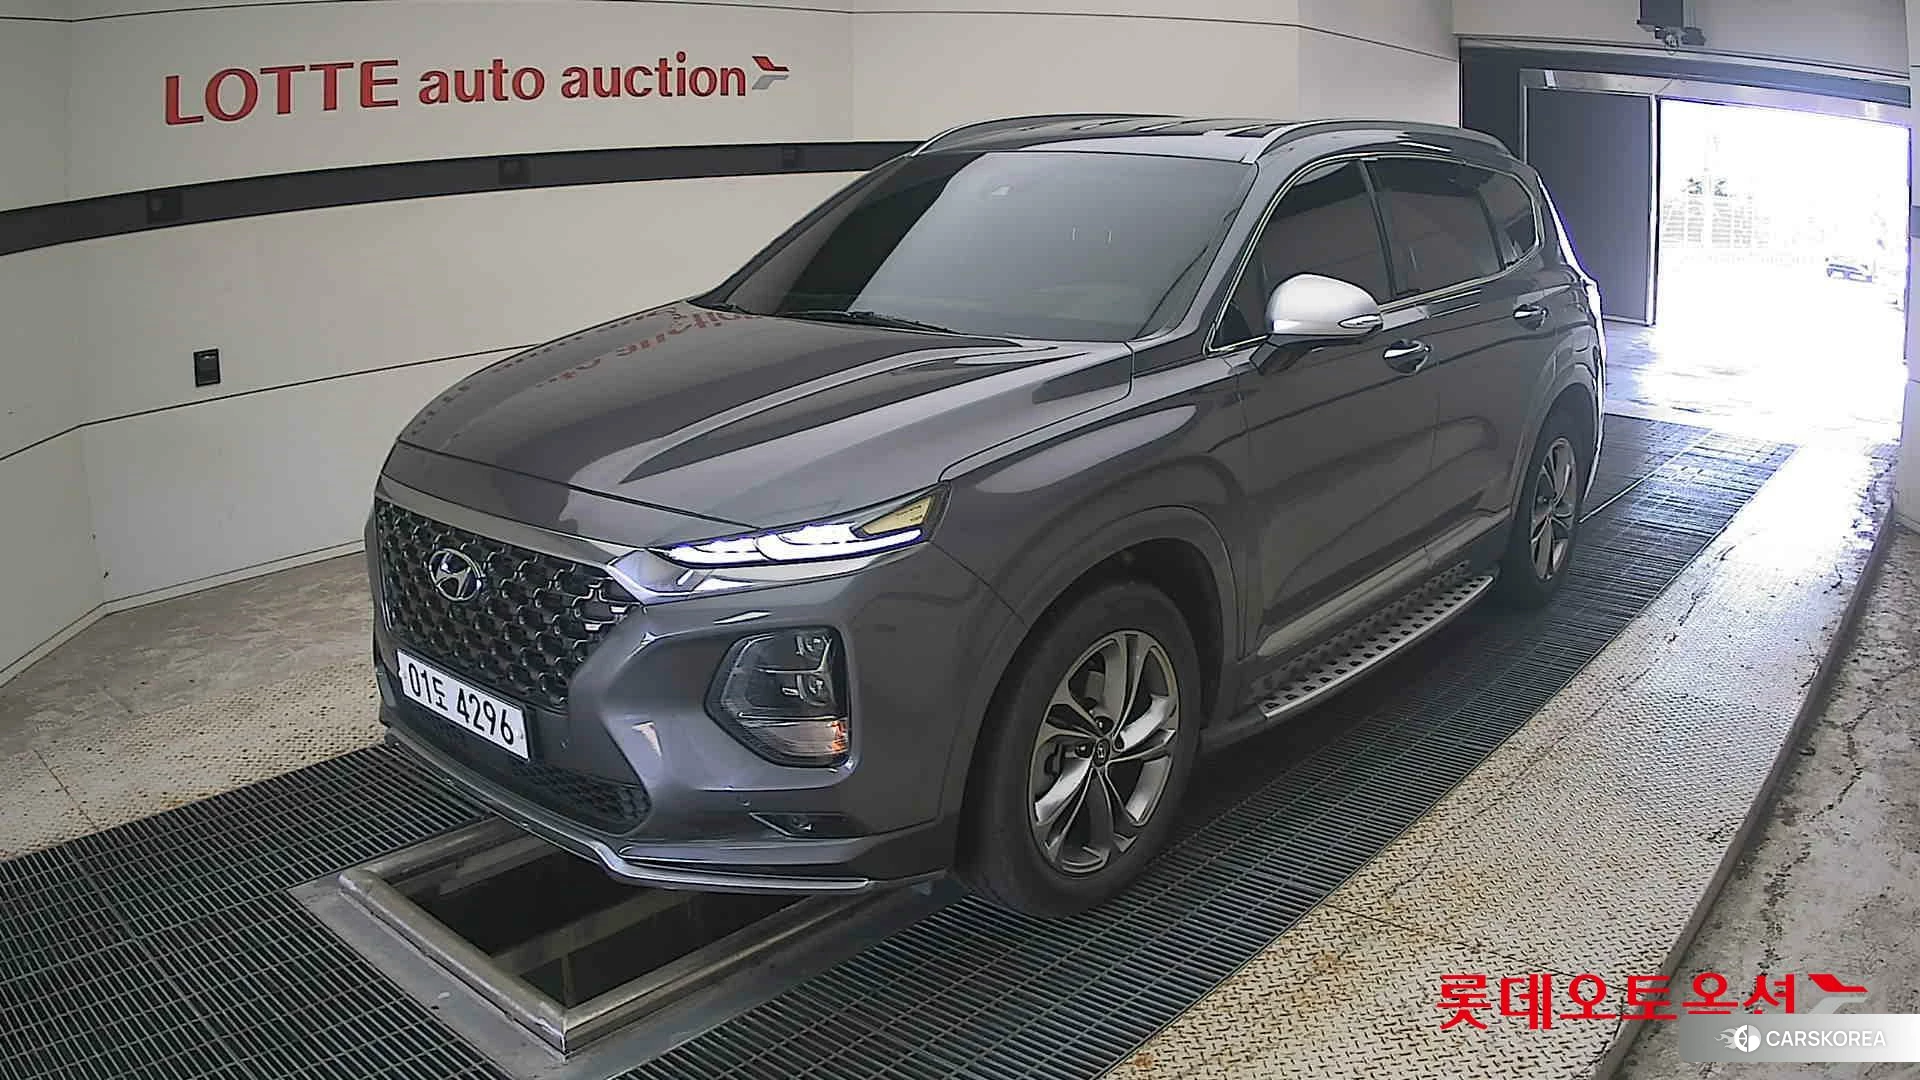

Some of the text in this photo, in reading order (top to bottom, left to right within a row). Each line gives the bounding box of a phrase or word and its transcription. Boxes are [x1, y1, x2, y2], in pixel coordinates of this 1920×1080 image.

[165, 51, 747, 126] LOTTE auto auction
[457, 687, 514, 745] 4296
